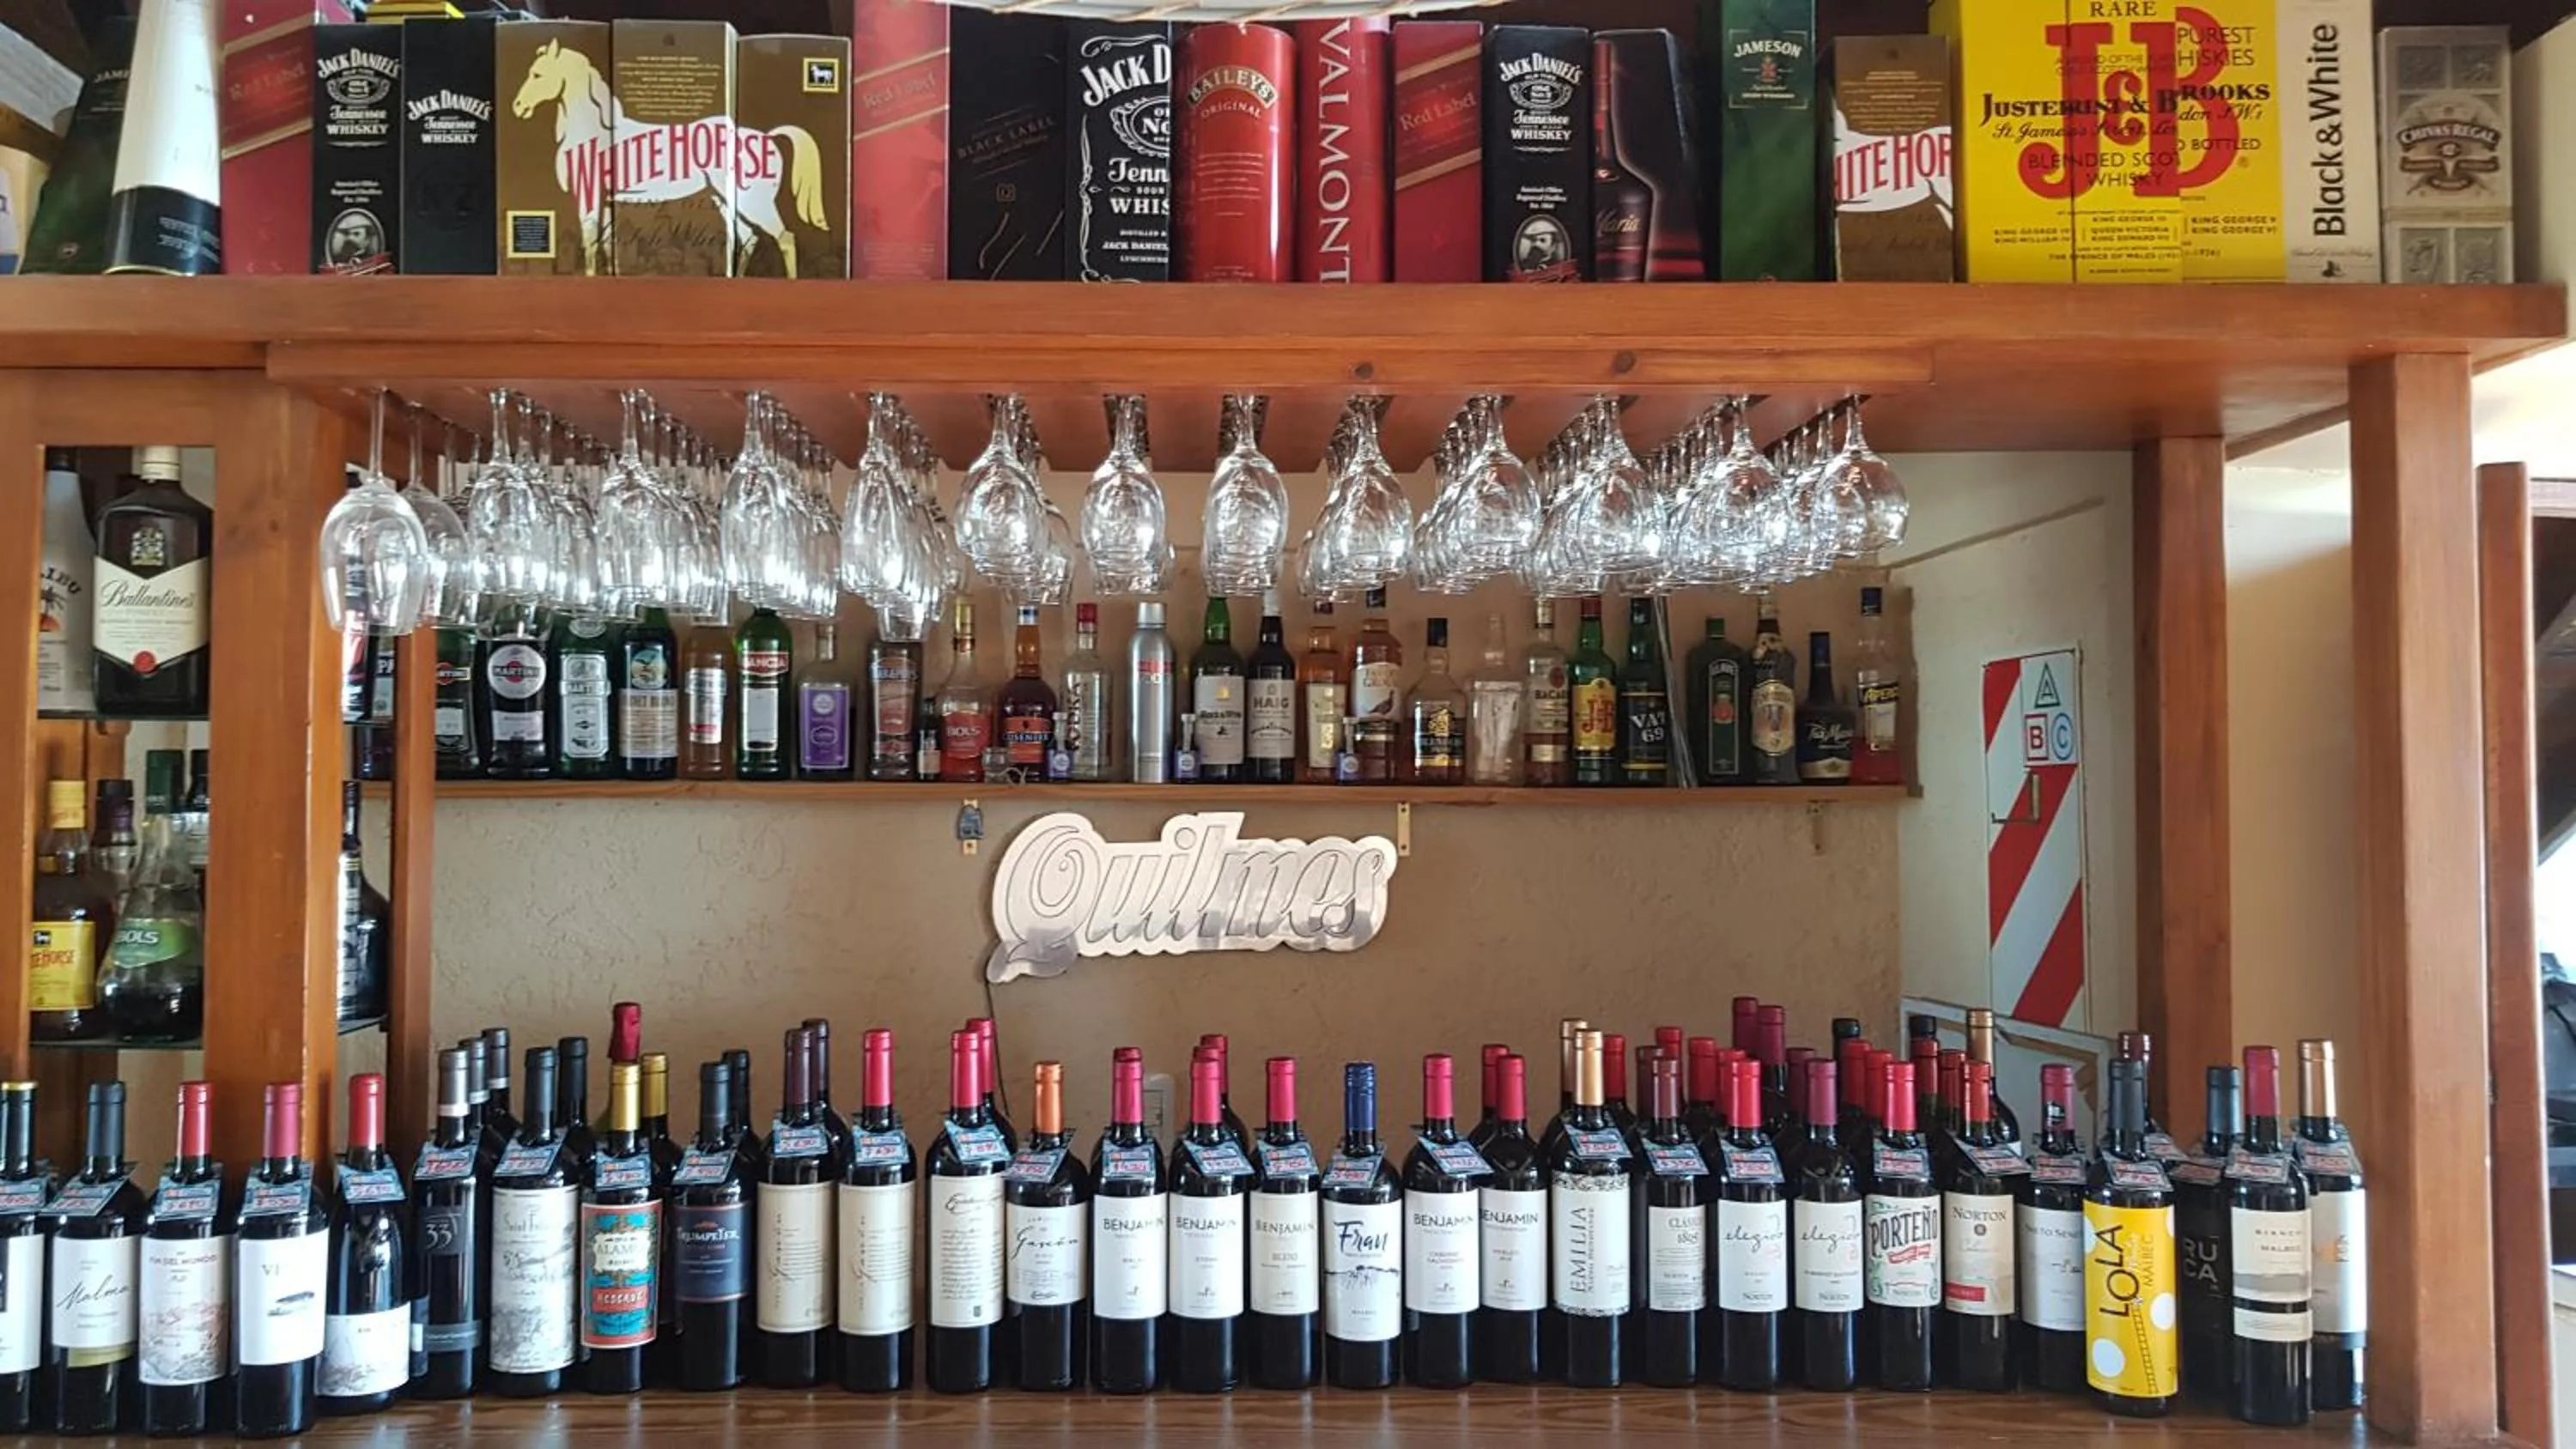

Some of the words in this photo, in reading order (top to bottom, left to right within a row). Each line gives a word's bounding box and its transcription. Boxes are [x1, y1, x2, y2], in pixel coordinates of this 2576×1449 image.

[2089, 0, 2159, 17] RARE
[2178, 27, 2257, 45] PUREST
[1733, 40, 1802, 58] JAMESON
[317, 53, 350, 79] JACK
[350, 46, 402, 79] DANIEL'S
[1499, 55, 1533, 83] JACK
[1532, 52, 1583, 85] DANIEL'S
[1079, 53, 1148, 107] JACK
[1188, 70, 1274, 102] BAILEYS
[406, 95, 441, 121] JACK
[440, 88, 494, 122] DANIEL'S
[1200, 100, 1263, 119] ORIGINAL
[1400, 107, 1434, 131] Red
[1433, 92, 1478, 121] Label
[325, 124, 388, 135] WHISKEY
[421, 133, 478, 143] WHISKEY
[957, 133, 1006, 160] BLACK
[1009, 115, 1058, 142] LABEL
[1510, 129, 1572, 141] WHISKEY
[2400, 124, 2450, 146] CHIVAS
[2451, 123, 2500, 144] REGAL
[1318, 16, 1352, 284] VALMONT
[2191, 137, 2262, 151] BOTTLED
[2027, 153, 2126, 170] BLENDED
[2086, 171, 2166, 188] WHISKY
[2191, 215, 2220, 225] KING
[2221, 215, 2268, 224] GEORGE
[100, 578, 197, 609] Ballantine's
[2040, 678, 2054, 700] A
[1253, 697, 1290, 709] HAIG
[1632, 712, 1666, 729] VAT
[1641, 727, 1664, 743] 69
[2029, 725, 2044, 749] B
[2056, 725, 2069, 749] C
[1003, 824, 1387, 965] Quilmes
[1413, 1212, 1474, 1228] BENJAMIN
[1952, 1205, 2008, 1222] NORTON
[1102, 1216, 1165, 1232] BENJAMIN
[1255, 1219, 1316, 1237] BENJAMIN
[1868, 1204, 1939, 1259] PORTEÑO
[1569, 1207, 1588, 1294] EMILIA
[2142, 1233, 2155, 1288] MALBEC
[2094, 1224, 2141, 1319] LOLA
